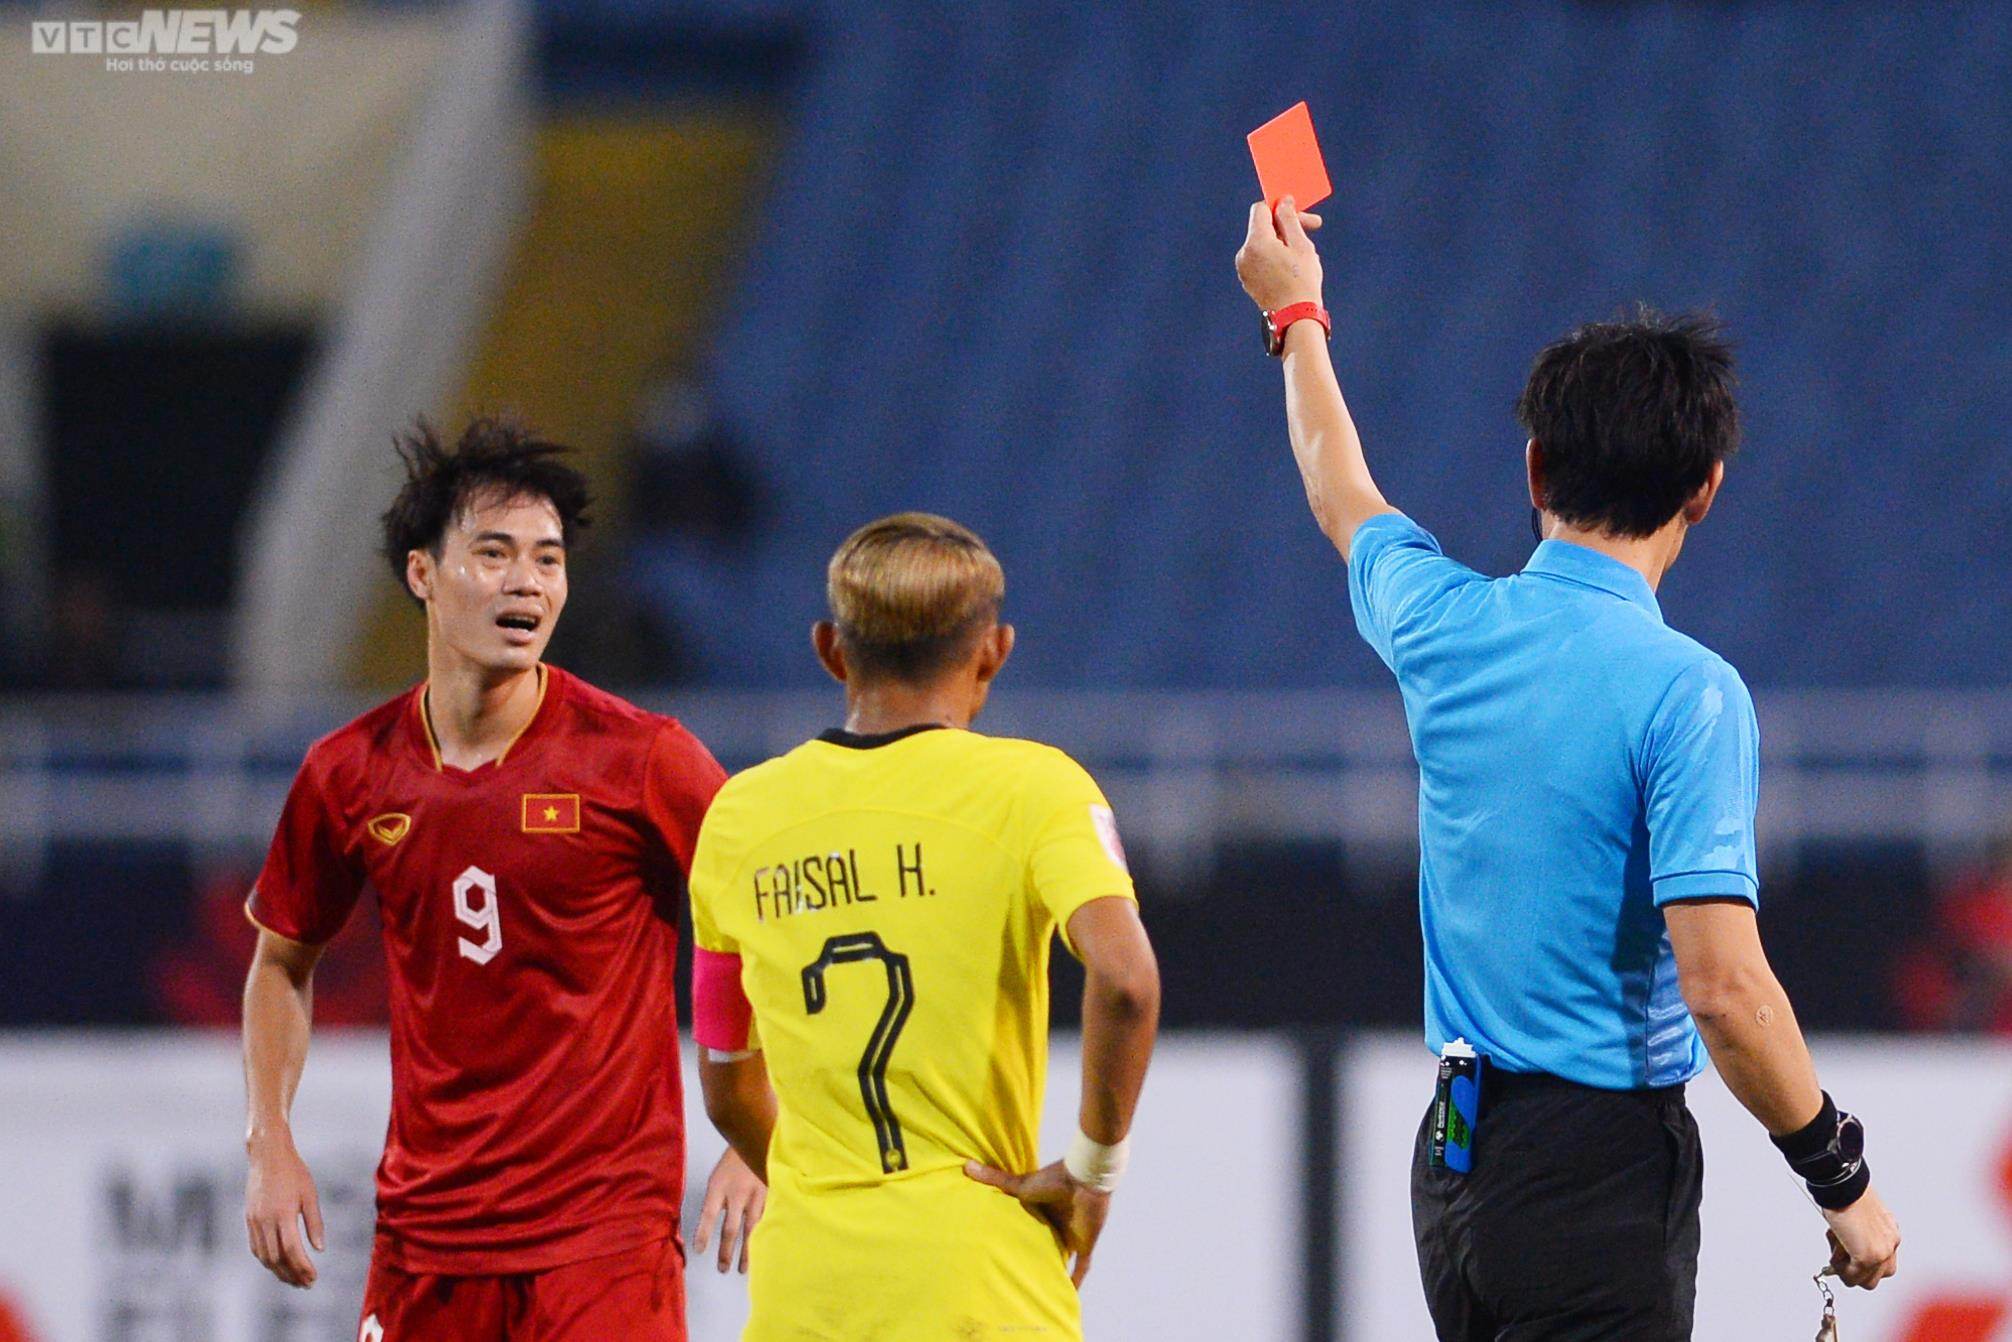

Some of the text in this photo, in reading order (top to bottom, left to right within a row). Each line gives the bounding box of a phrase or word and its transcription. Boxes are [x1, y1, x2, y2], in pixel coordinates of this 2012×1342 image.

[452, 865, 502, 965] 9
[754, 842, 936, 924] FAISAL H.
[801, 931, 915, 1174] 7
